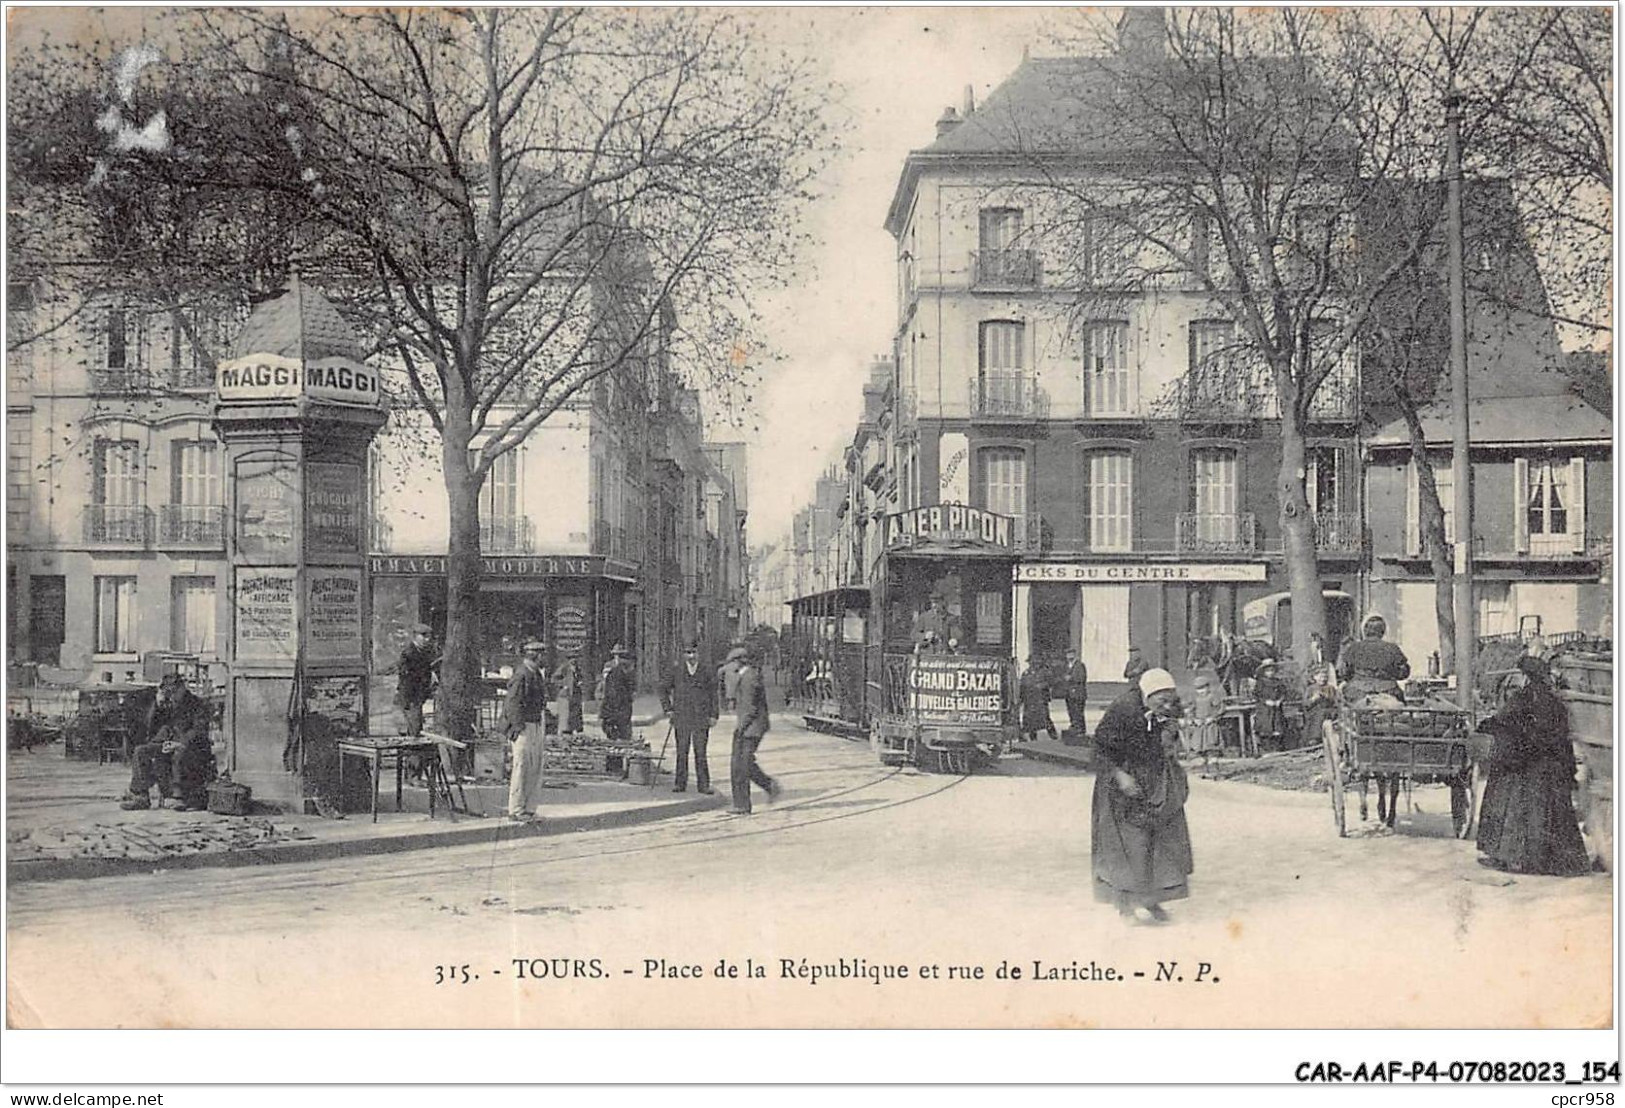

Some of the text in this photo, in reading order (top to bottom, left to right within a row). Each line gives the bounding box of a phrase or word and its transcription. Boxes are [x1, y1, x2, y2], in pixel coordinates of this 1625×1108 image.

[222, 364, 298, 387] MAGGI
[307, 367, 376, 392] MAGGI
[888, 506, 1008, 547] AMER PICON
[372, 558, 592, 574] RMACI MODERNE
[1018, 567, 1067, 578] CKS
[1075, 568, 1099, 578] DU
[1107, 567, 1190, 578] CENTRE
[911, 669, 1001, 691] GRAND BAZAR
[957, 695, 1000, 711] GALERIES
